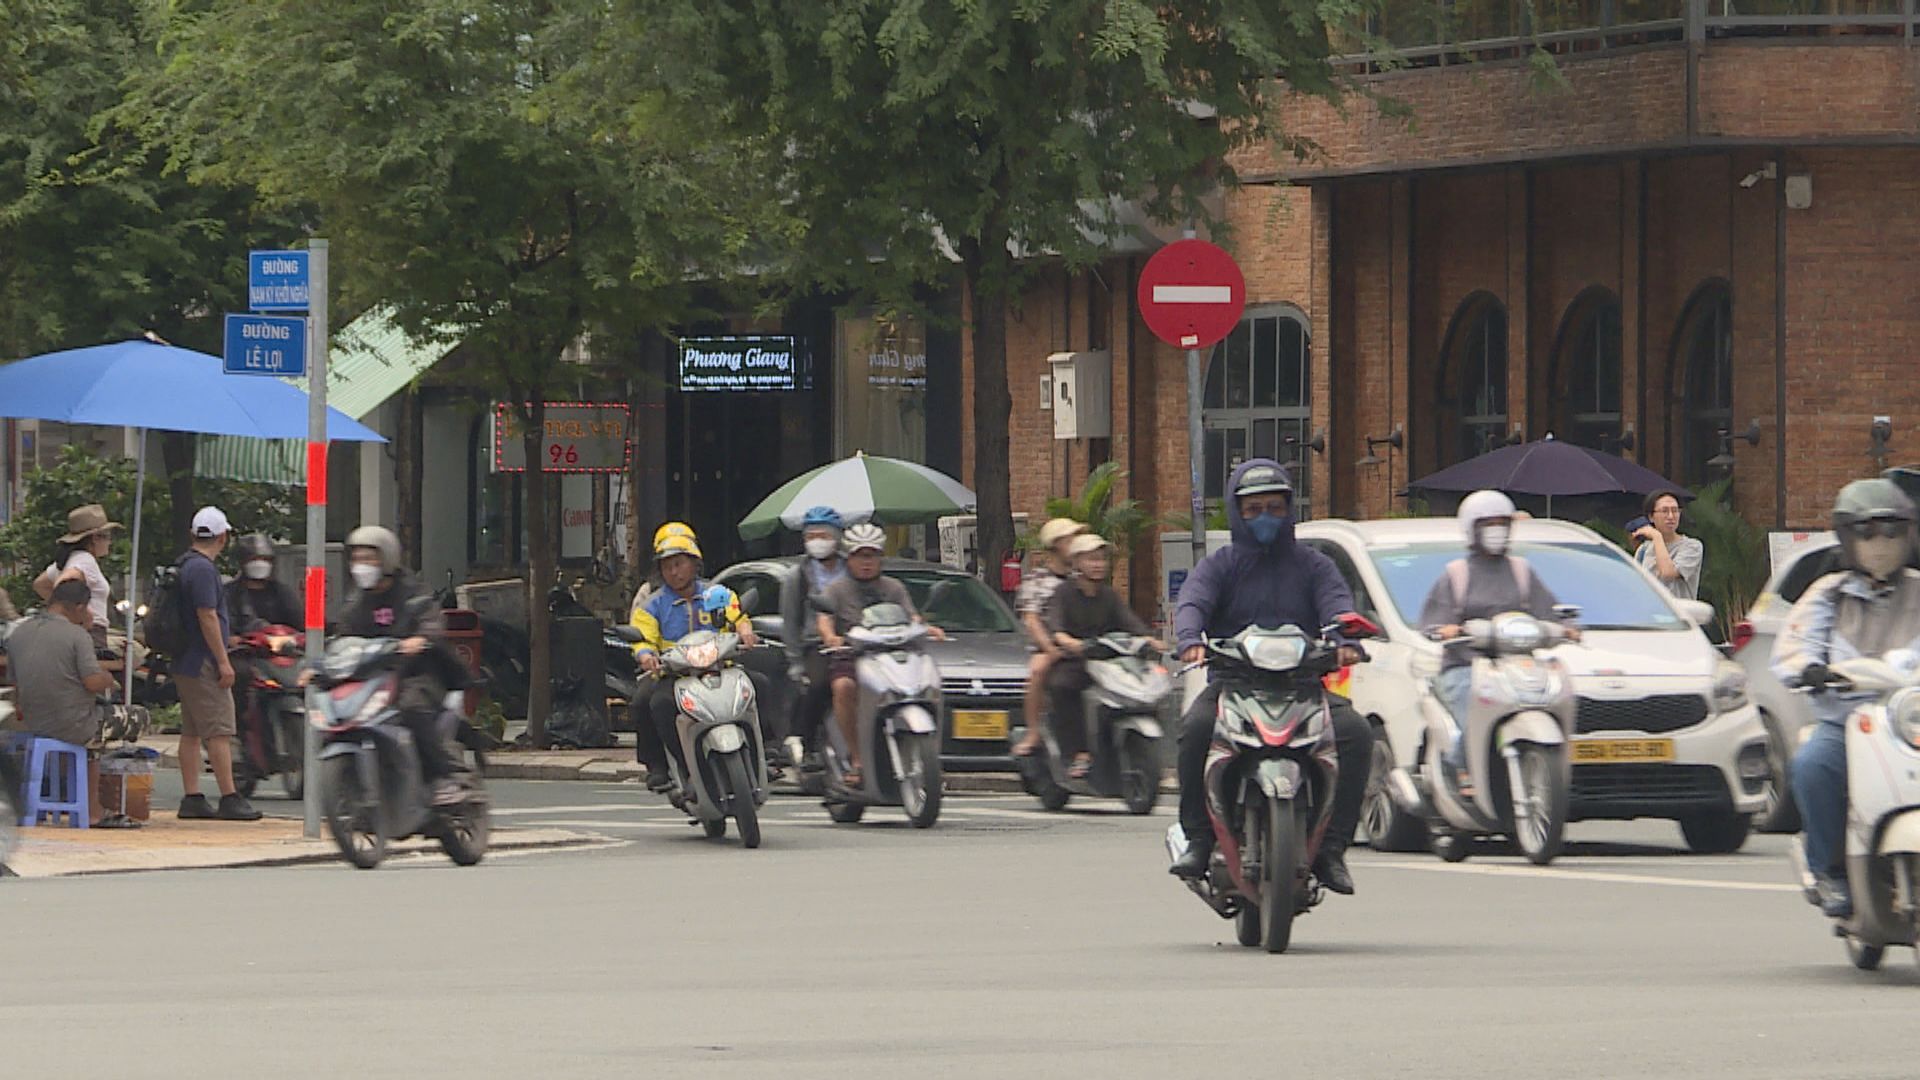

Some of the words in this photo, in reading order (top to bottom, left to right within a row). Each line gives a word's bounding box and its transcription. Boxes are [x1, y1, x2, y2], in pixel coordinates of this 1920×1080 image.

[262, 257, 298, 275] ĐƯỜNG
[242, 321, 290, 339] ĐƯỜNG
[246, 344, 261, 368] LÊ
[265, 349, 283, 373] LỢI
[684, 347, 742, 371] Phương
[745, 347, 790, 370] Giang
[549, 444, 578, 464] 96
